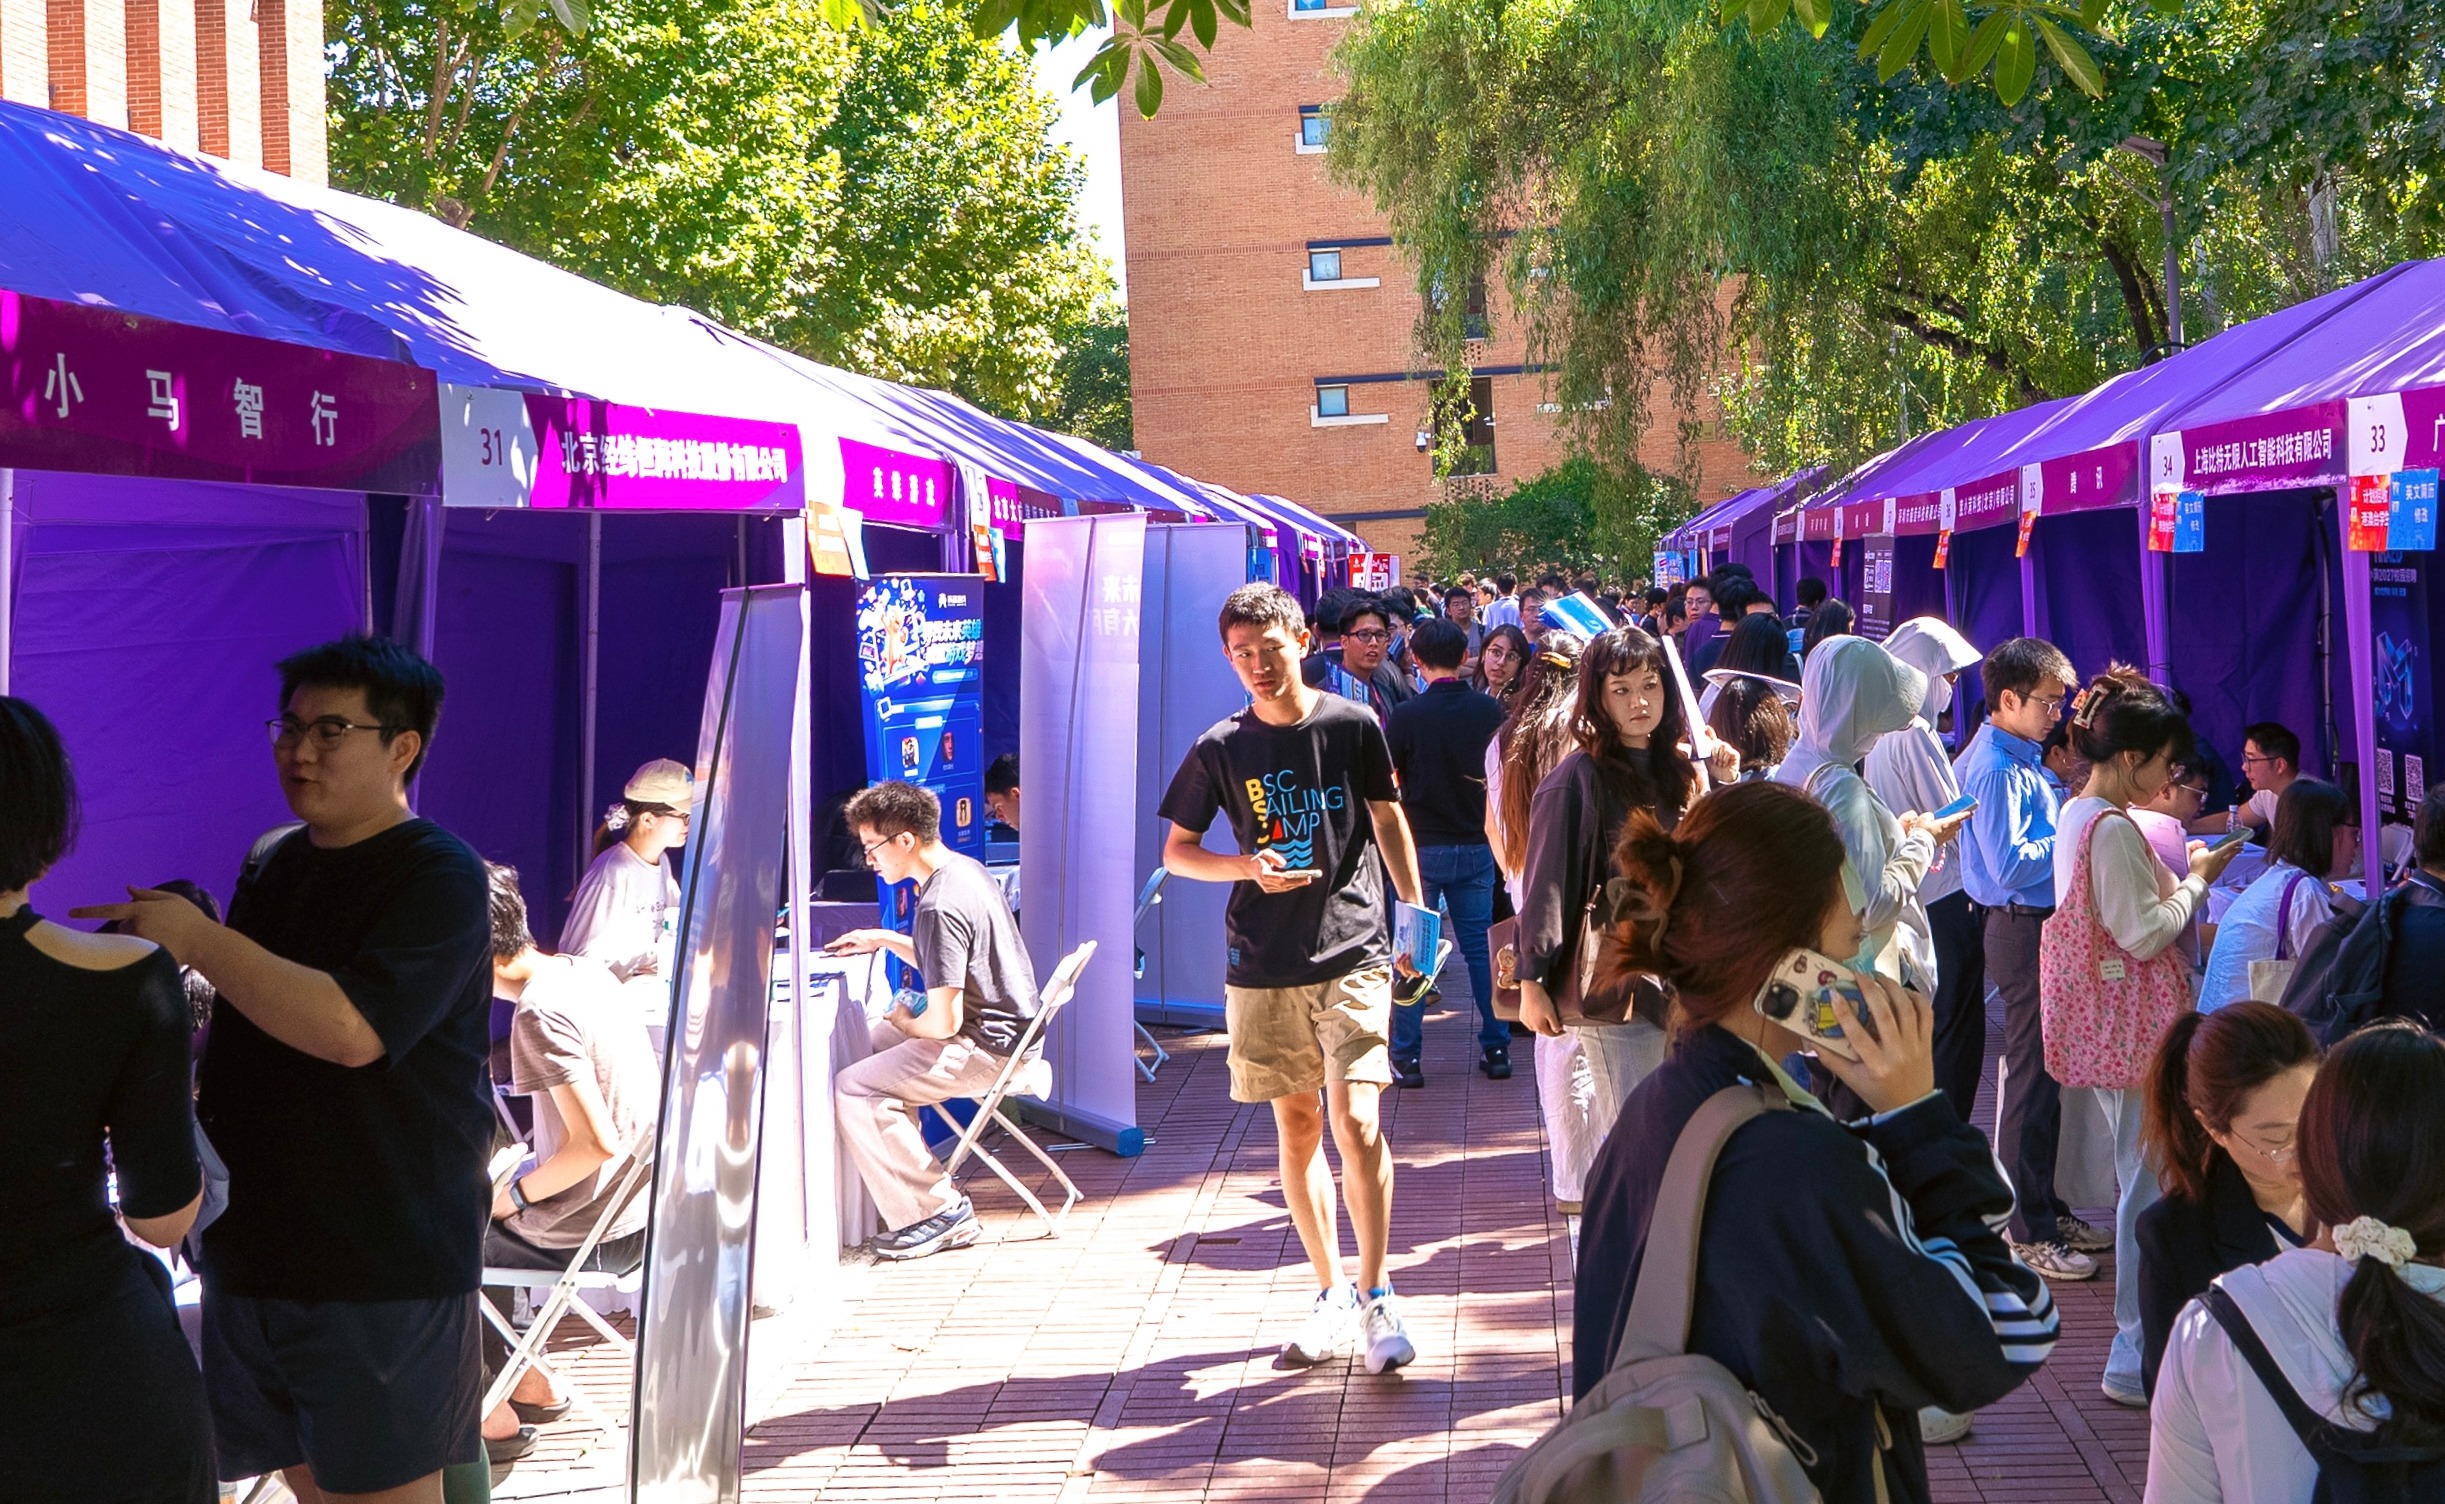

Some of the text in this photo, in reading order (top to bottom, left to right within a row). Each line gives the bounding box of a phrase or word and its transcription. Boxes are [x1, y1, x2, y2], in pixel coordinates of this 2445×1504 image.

[44, 352, 338, 446] 小马智行
[480, 427, 503, 466] 31
[2193, 427, 2333, 476] 上海比特无限人工智能科技有限公司
[2370, 424, 2386, 452] 33
[2163, 455, 2173, 477] 34
[2405, 483, 2435, 501] 英文简历
[1245, 768, 1297, 802] BSC
[1252, 786, 1344, 822] SAILING
